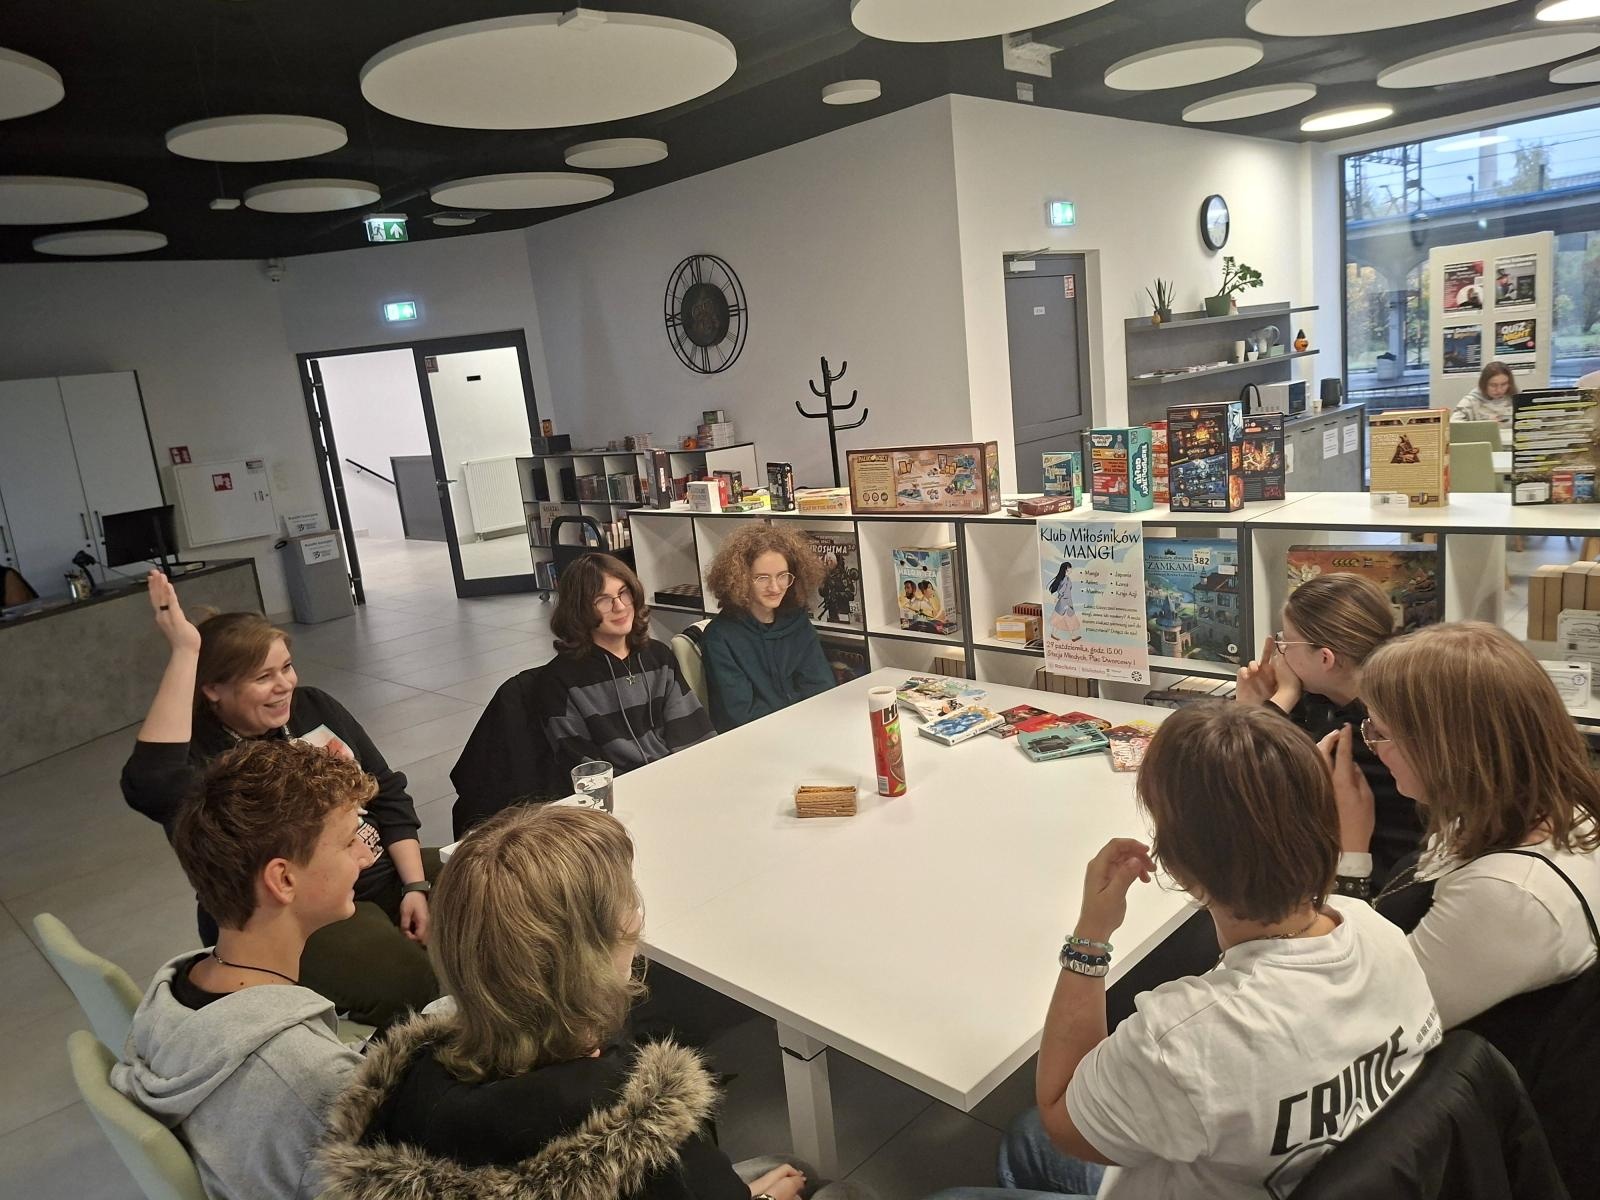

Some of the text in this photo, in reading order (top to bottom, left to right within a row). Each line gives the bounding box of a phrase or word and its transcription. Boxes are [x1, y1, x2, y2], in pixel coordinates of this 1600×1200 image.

[1501, 322, 1527, 334] QUIZ
[1040, 528, 1140, 543] Klub Miłośników
[1063, 545, 1115, 560] MANGI
[1147, 561, 1195, 572] ZAMKAMI
[1194, 557, 1210, 565] 382
